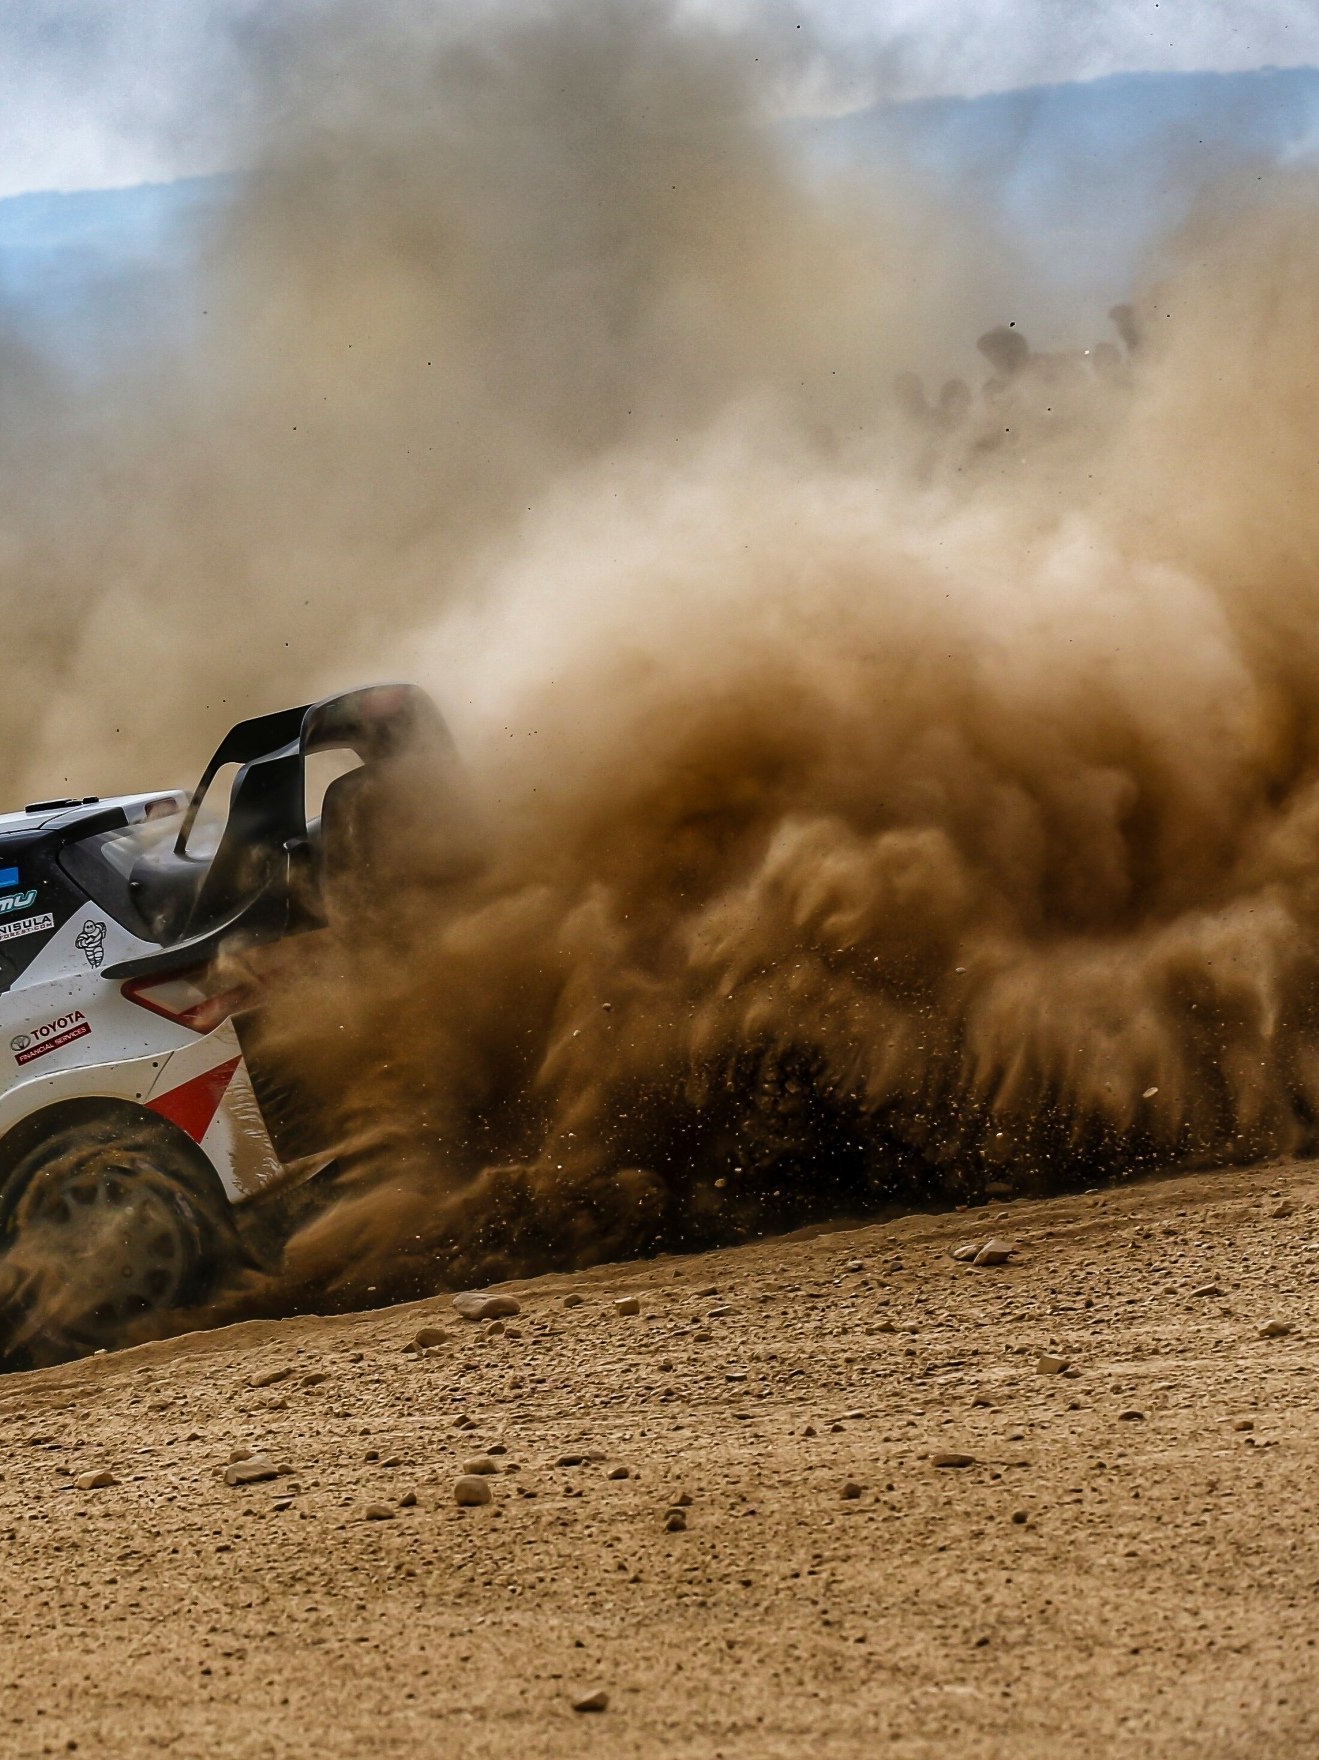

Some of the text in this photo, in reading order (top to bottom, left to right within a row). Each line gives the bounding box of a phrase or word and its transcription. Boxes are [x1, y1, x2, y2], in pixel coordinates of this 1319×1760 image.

[30, 1010, 86, 1041] TOYOTA
[20, 1026, 87, 1062] FINANCIAL SERVICES
